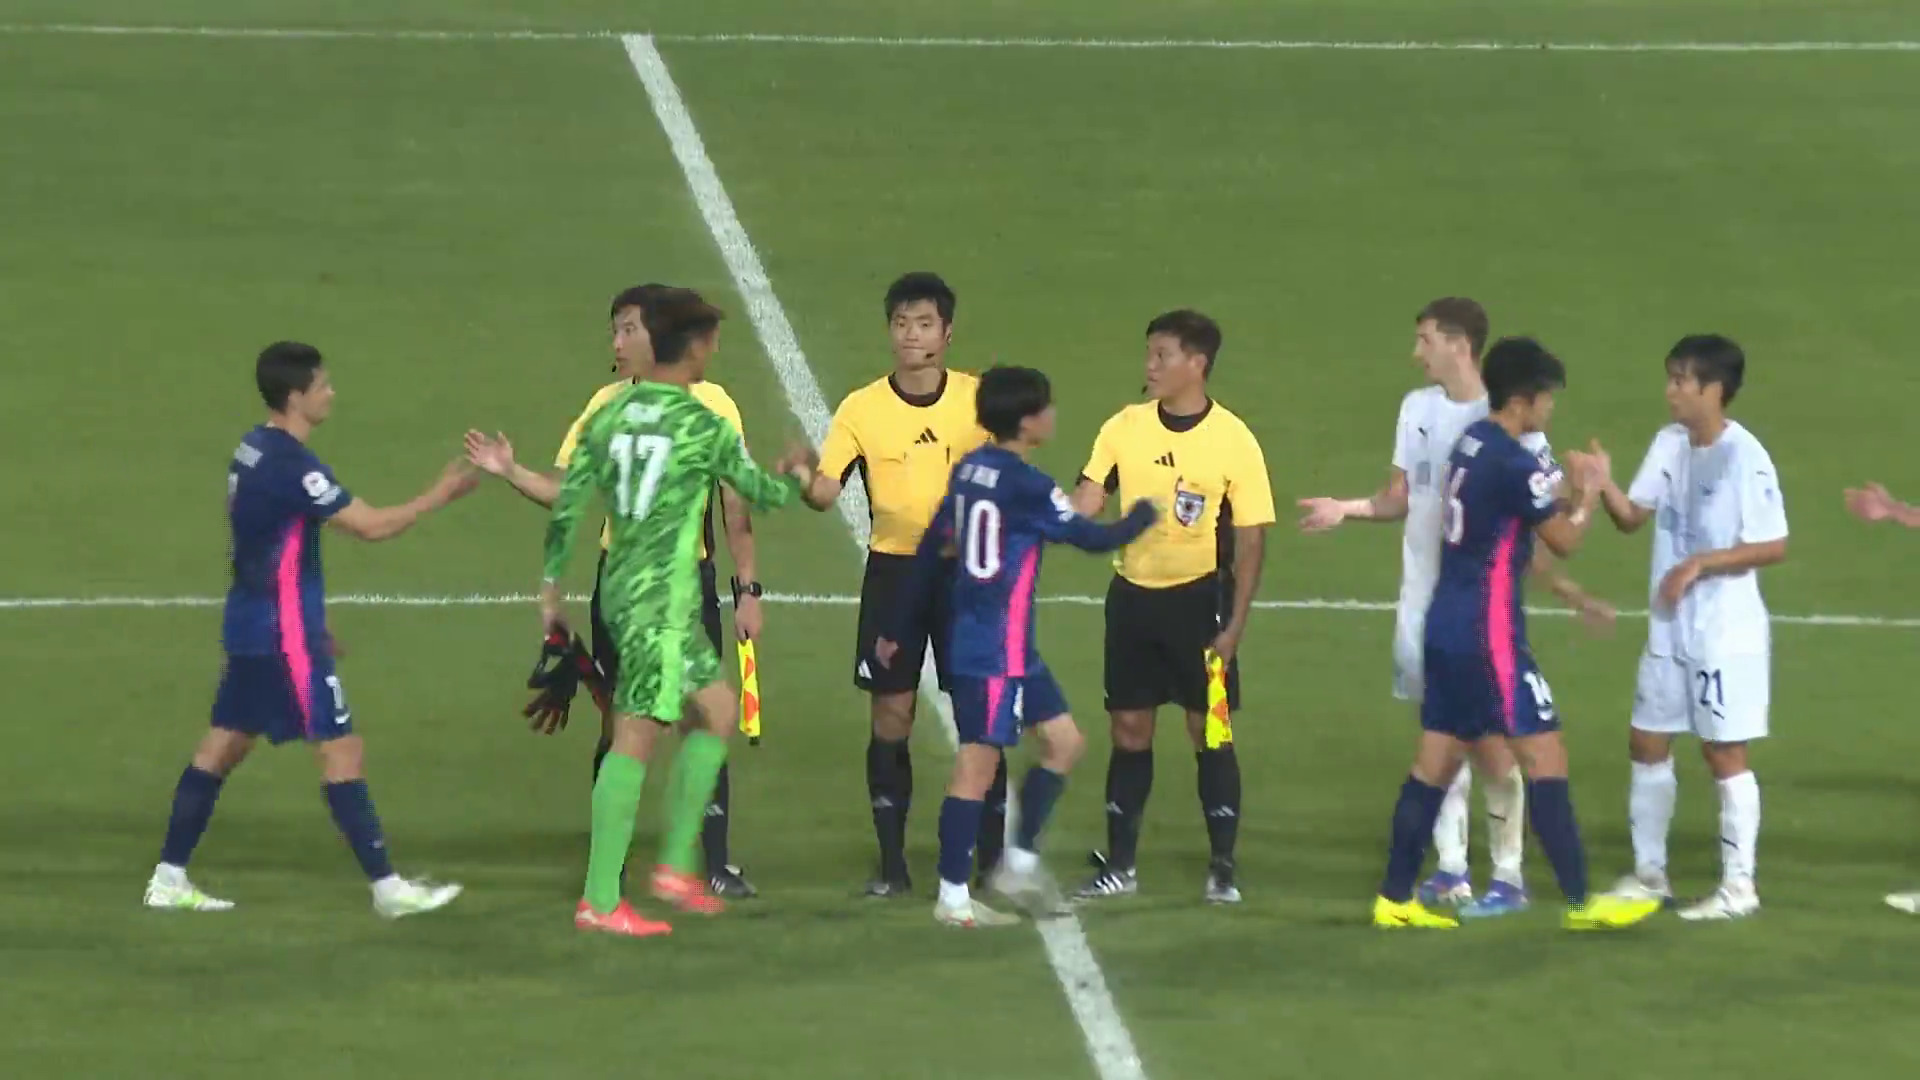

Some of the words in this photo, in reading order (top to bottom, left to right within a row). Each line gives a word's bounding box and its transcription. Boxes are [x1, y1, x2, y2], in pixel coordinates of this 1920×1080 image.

[609, 433, 672, 521] 17
[955, 494, 1001, 579] 10
[1696, 669, 1723, 706] 21
